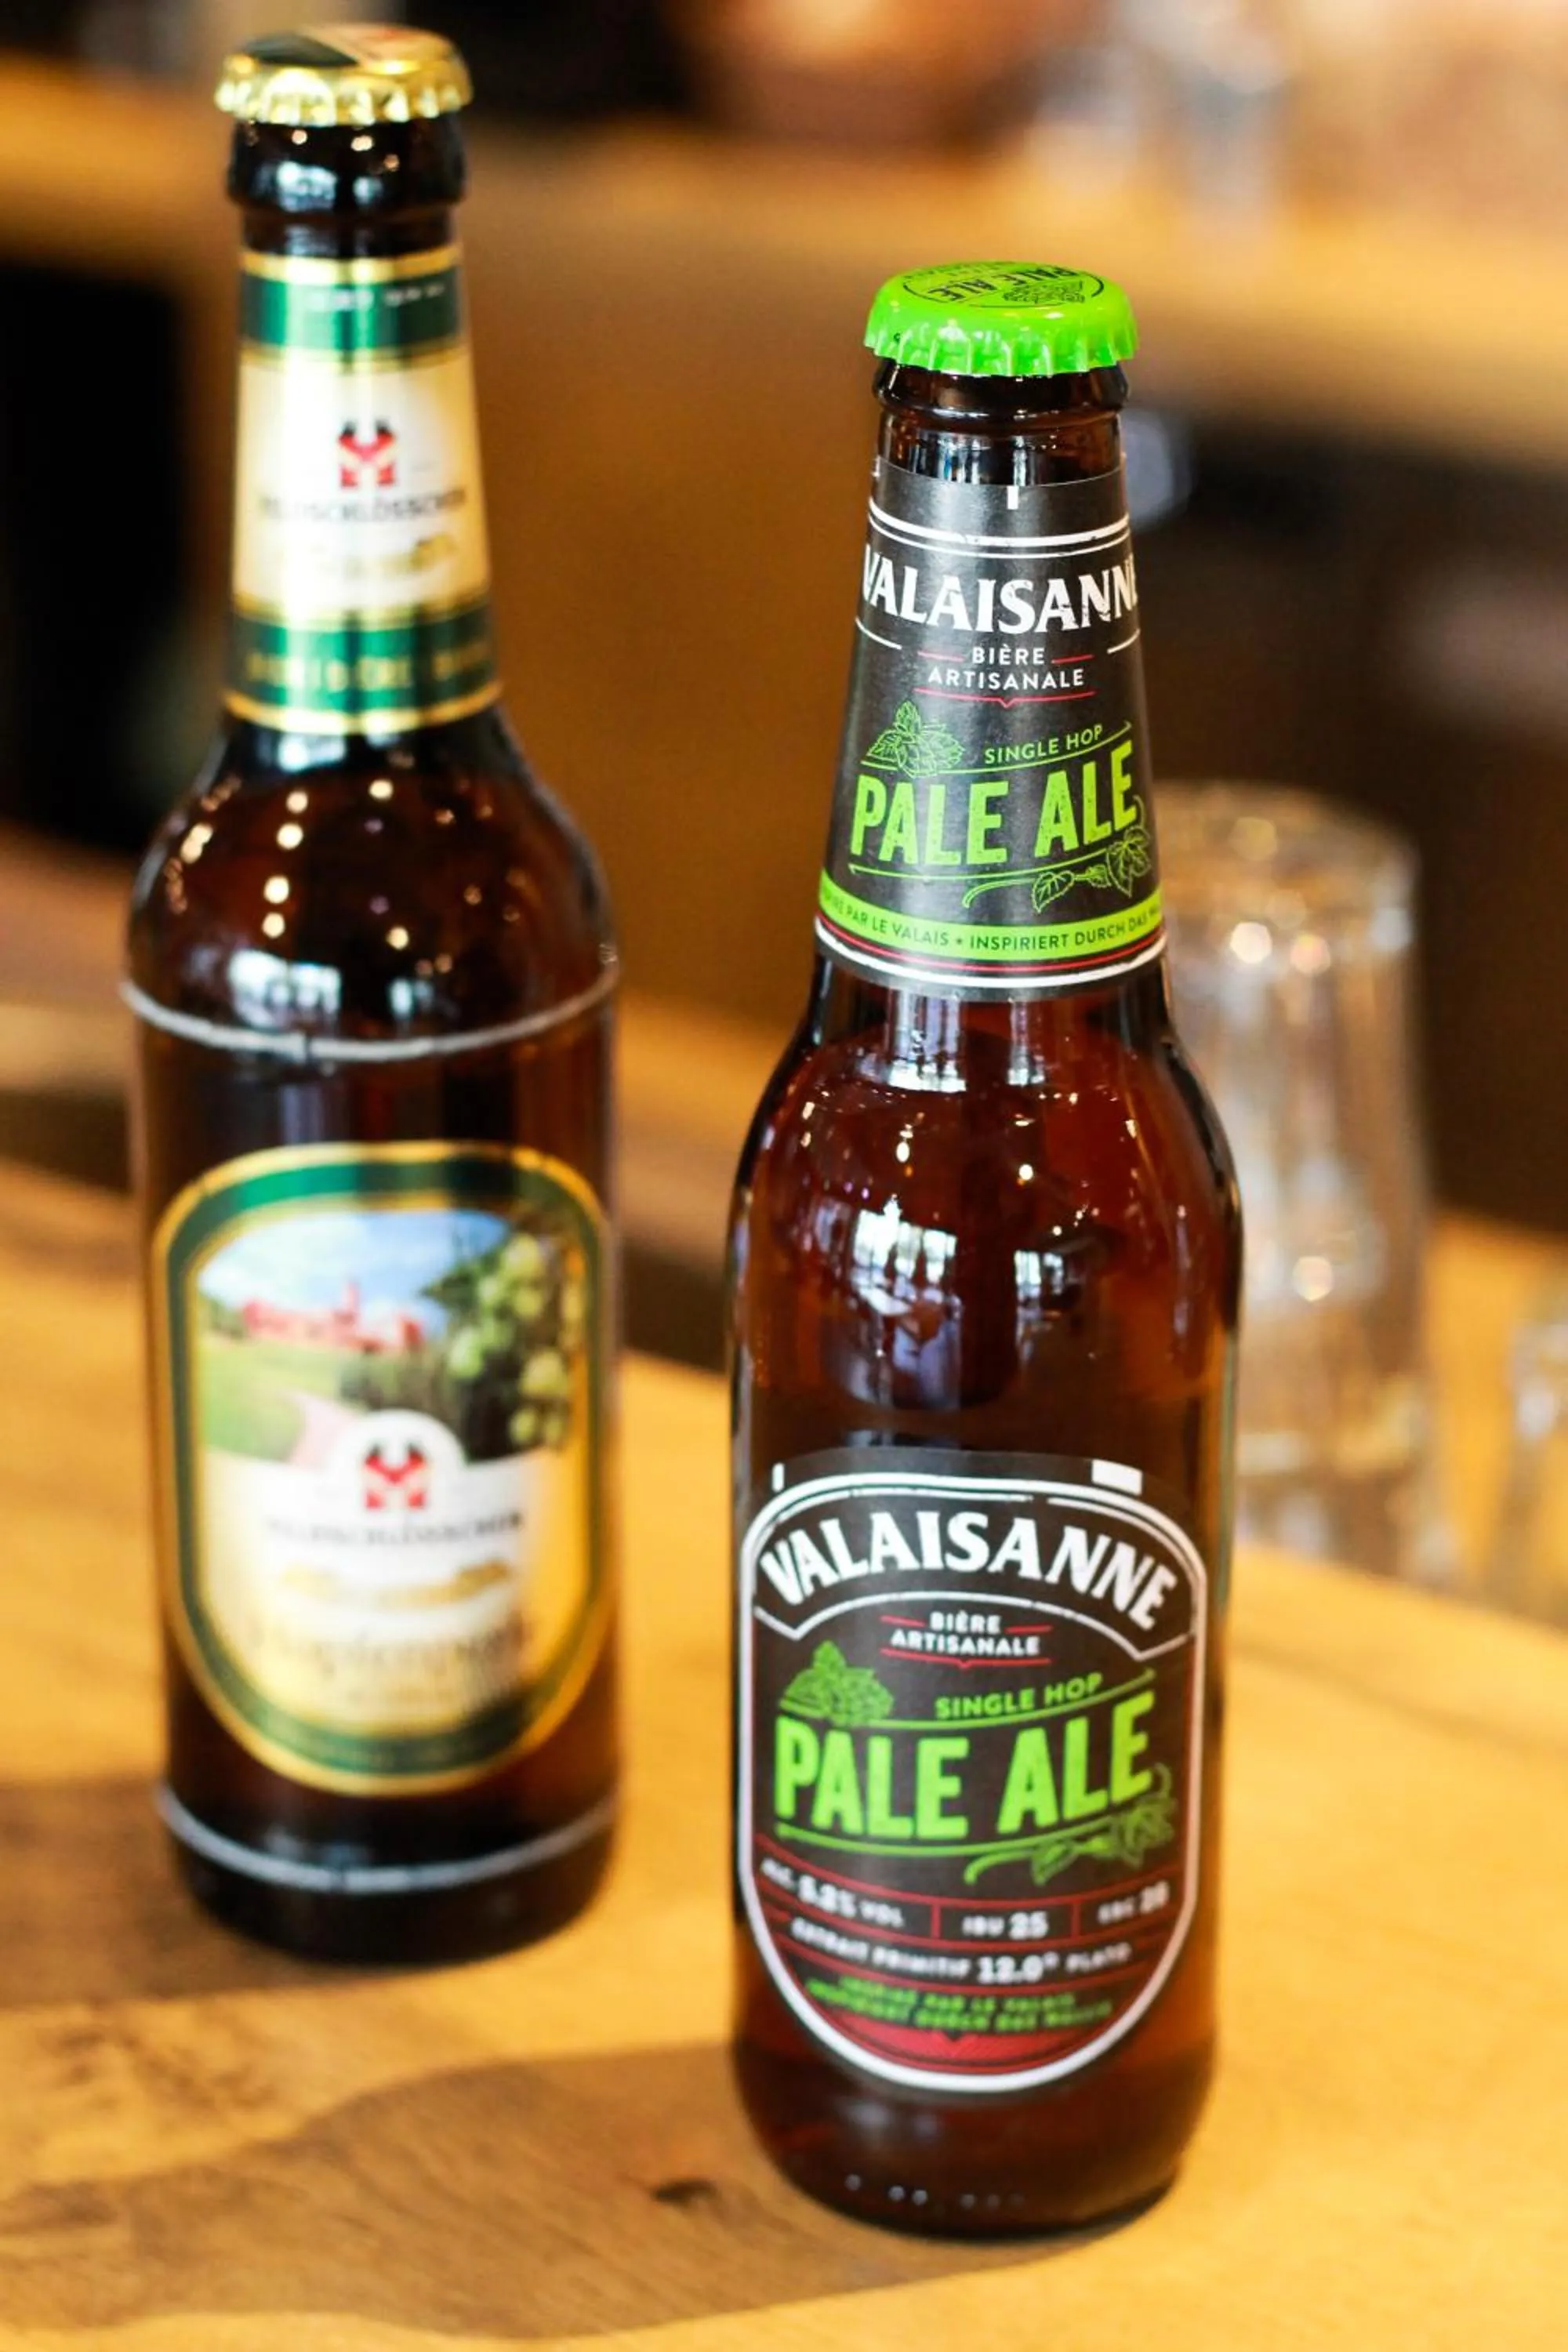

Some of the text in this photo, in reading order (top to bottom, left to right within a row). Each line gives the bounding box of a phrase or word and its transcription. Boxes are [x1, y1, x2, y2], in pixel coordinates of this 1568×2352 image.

[927, 278, 997, 302] ALE
[862, 544, 1138, 633] VALAISANN
[971, 644, 1045, 666] BIÈRE
[927, 667, 1084, 690] ARTISANALE
[984, 724, 1103, 765] SINGLE HOP
[850, 739, 1137, 865] PALE ALE
[846, 909, 868, 927] PAR
[872, 917, 889, 934] LE
[892, 923, 949, 945] VALAIS
[970, 934, 1069, 951] INSPIRIERT
[1074, 923, 1126, 946] DURCH
[760, 1511, 1178, 1631] VALAISANNE
[930, 1610, 1001, 1632] BIÈRE
[890, 1630, 1040, 1656] ARTISANALE
[935, 1671, 1103, 1720] SINGLE HOP
[774, 1691, 1155, 1840] PALE ALE
[1009, 1911, 1049, 1940] 25
